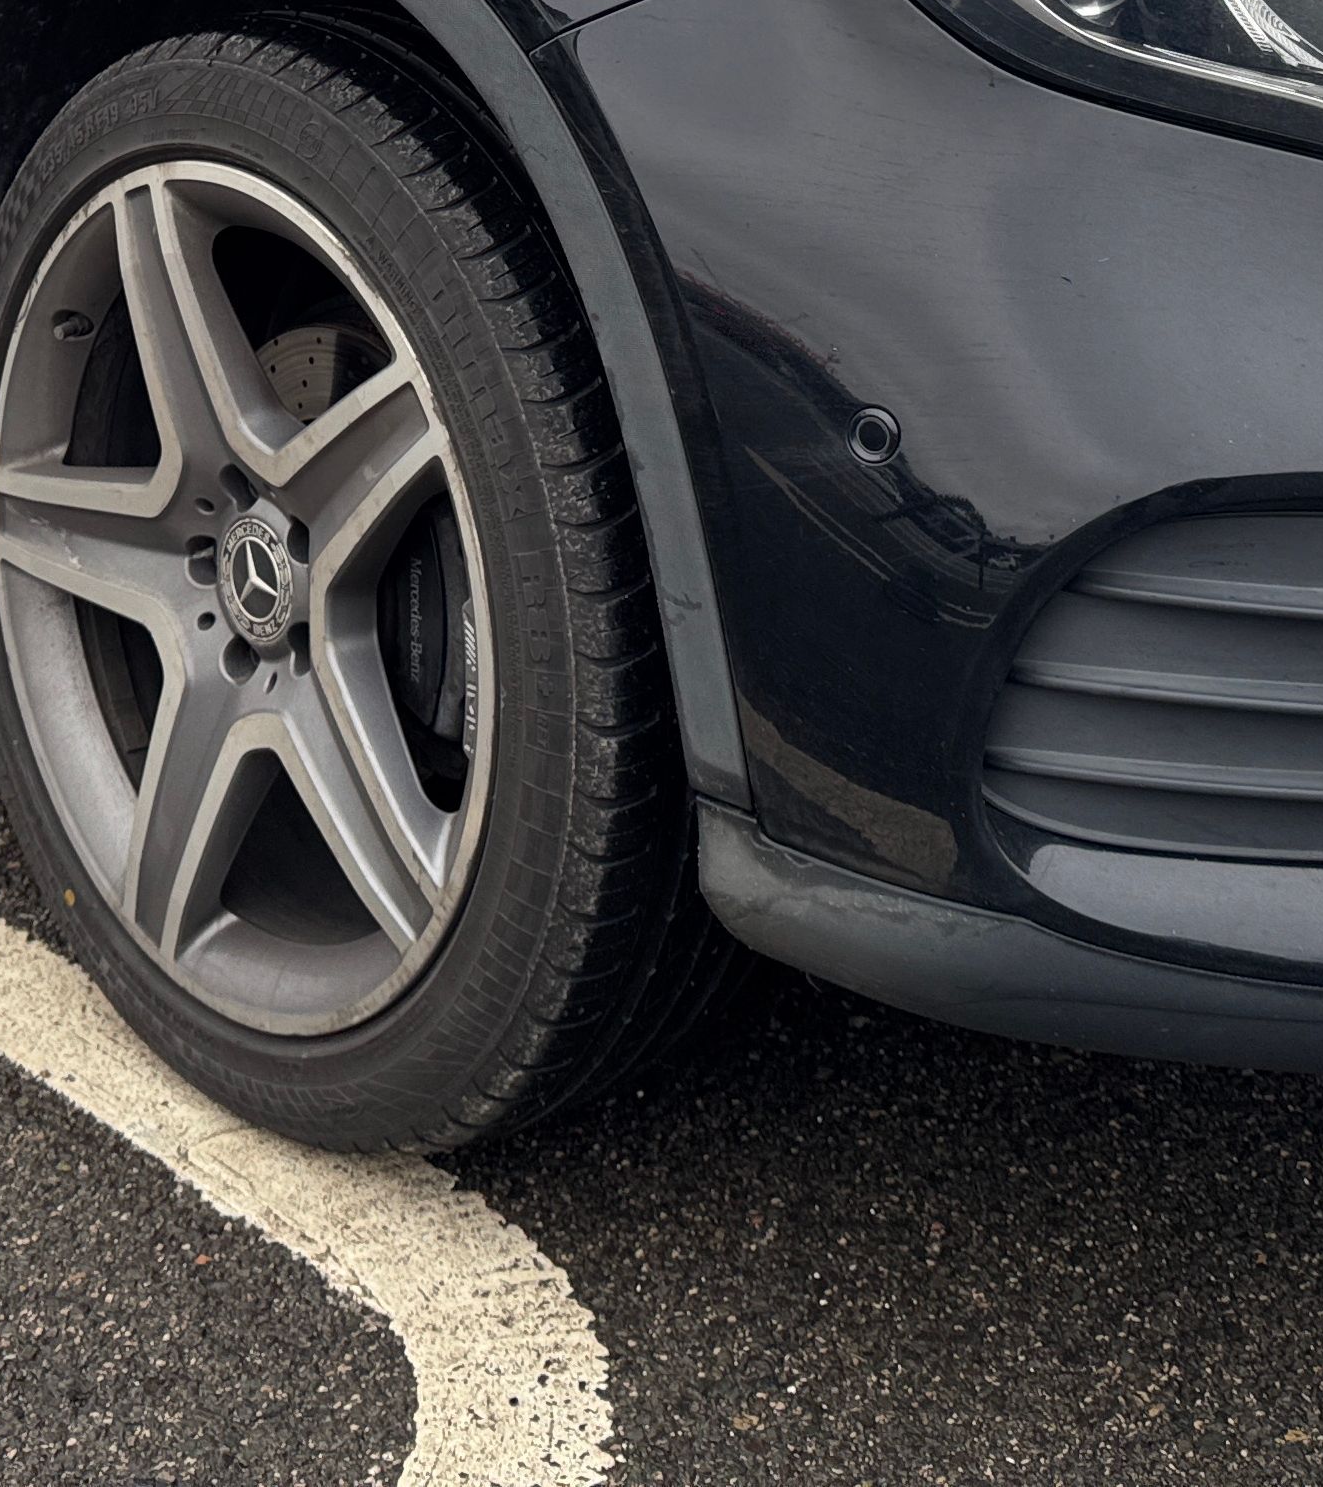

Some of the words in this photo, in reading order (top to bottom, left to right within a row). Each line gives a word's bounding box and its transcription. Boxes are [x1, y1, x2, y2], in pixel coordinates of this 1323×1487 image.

[225, 523, 271, 553] MERCEDES
[252, 621, 279, 638] BENZ
[410, 558, 423, 683] Mercedes-Benz
